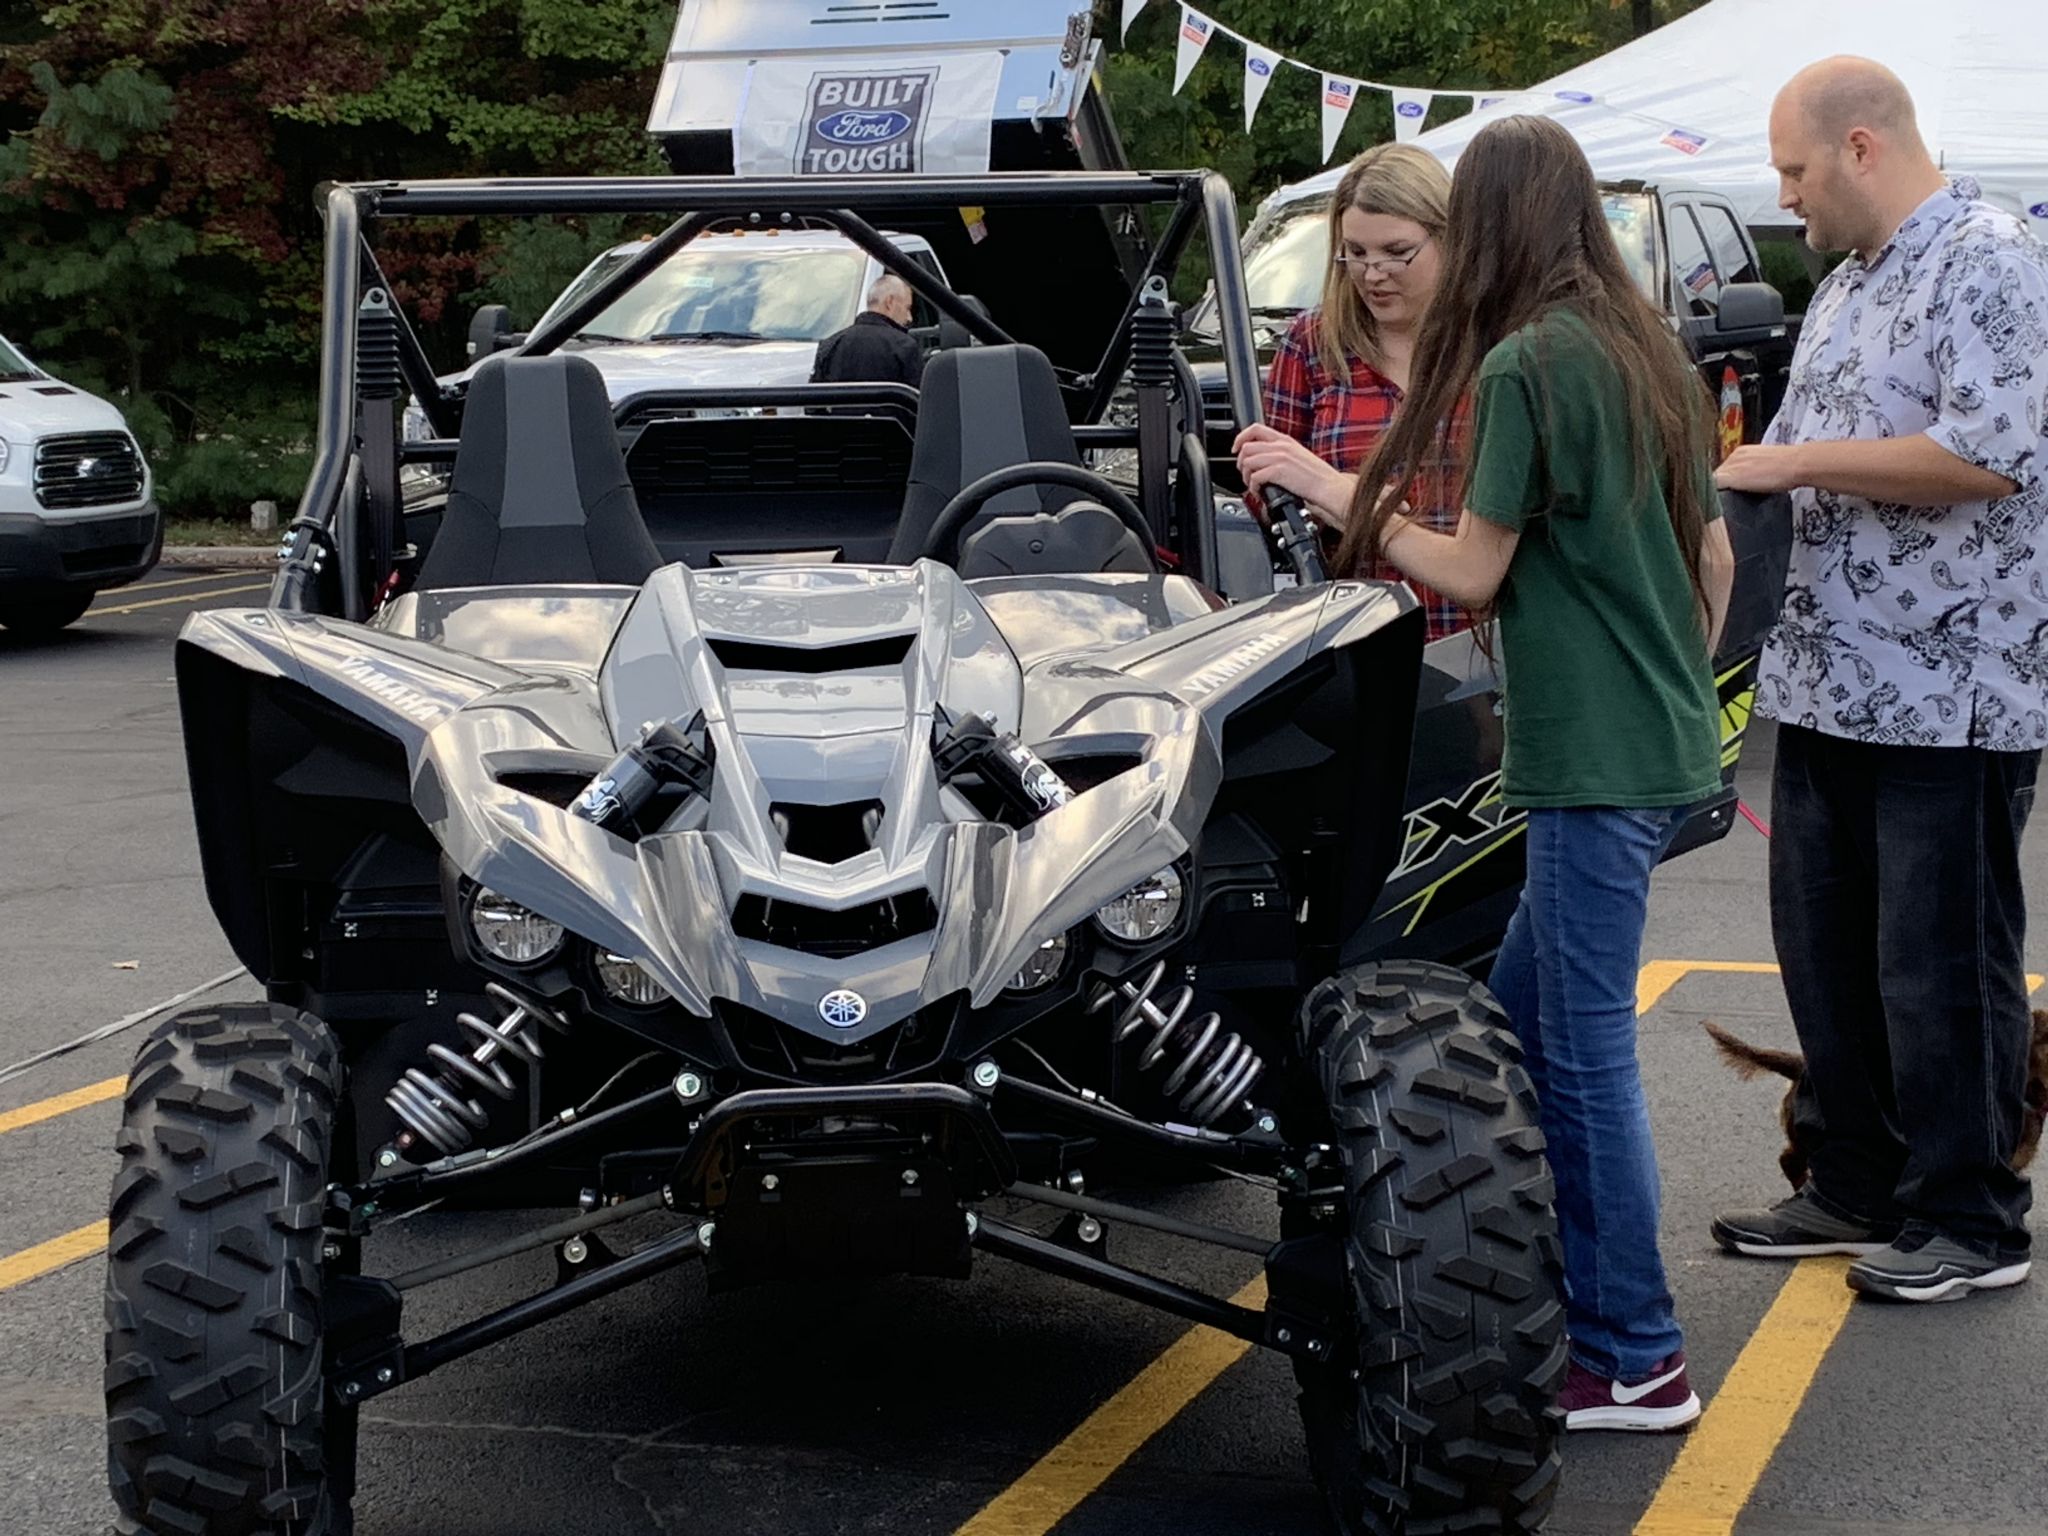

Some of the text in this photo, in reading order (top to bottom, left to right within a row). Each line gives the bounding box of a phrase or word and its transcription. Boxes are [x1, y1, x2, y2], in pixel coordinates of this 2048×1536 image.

[818, 77, 925, 108] BUILT
[832, 112, 892, 139] Ford
[808, 142, 908, 173] TOUGH
[1182, 632, 1289, 694] YAMAHA
[336, 655, 440, 722] YAMAHA
